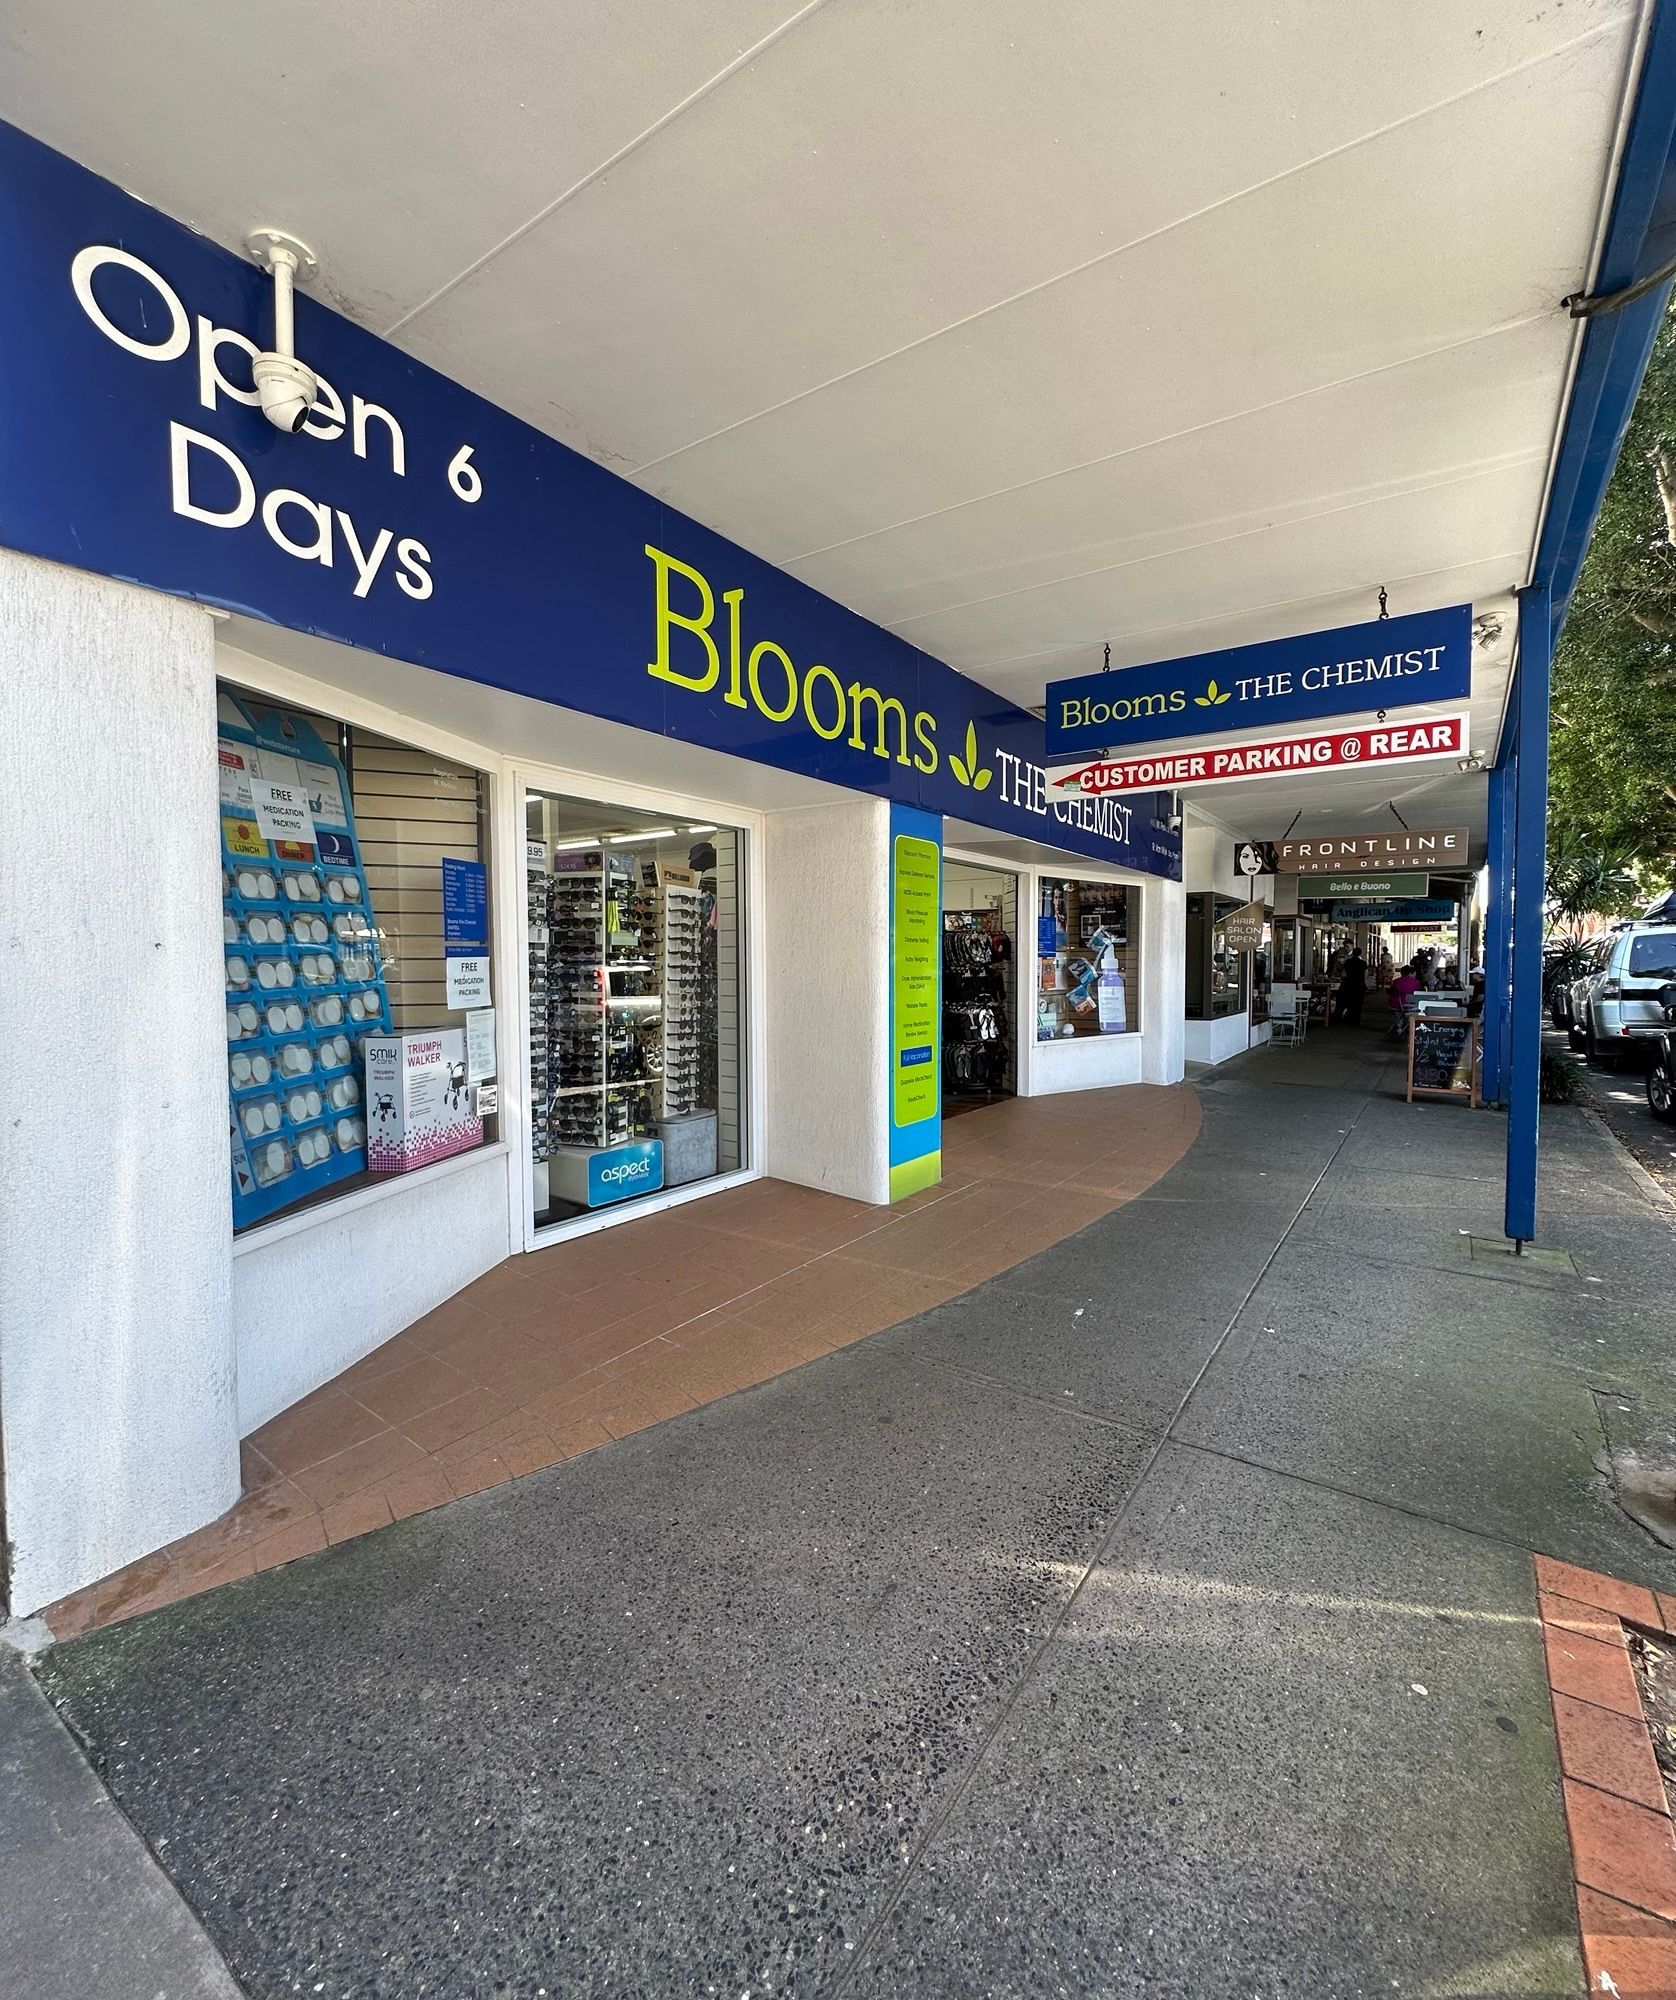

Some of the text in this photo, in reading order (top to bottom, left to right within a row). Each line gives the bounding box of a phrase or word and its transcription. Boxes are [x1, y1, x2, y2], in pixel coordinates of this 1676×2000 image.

[71, 245, 483, 503] Open 6
[169, 420, 434, 601] Days
[644, 543, 938, 775] Blooms
[995, 747, 1047, 816] THE
[1060, 646, 1445, 729] Blooms THE CHEMIST
[1079, 724, 1453, 790] CUSTOMER PARKING @ REAR
[270, 788, 293, 802] FREE
[263, 804, 304, 817] MEDICATION
[272, 818, 301, 830] PACKING
[234, 843, 260, 855] LUNCH
[1283, 835, 1456, 857] FRONTLINE
[323, 854, 350, 866] BEDTIME
[1298, 857, 1436, 870] HAIR DESIGN
[1330, 883, 1352, 891] Bello
[1360, 882, 1391, 891] Buono
[1336, 906, 1390, 918] Anglican
[1418, 903, 1451, 915] Shop
[1232, 917, 1256, 925] HAIR
[1226, 926, 1262, 934] SALON
[1229, 935, 1257, 943] OPEN
[461, 962, 478, 972] FREE
[454, 977, 484, 986] MEDICATION
[459, 988, 480, 997] PACKING
[407, 1040, 442, 1055] TRIUMPH
[407, 1052, 441, 1067] WALKER
[601, 1157, 650, 1184] aspect
